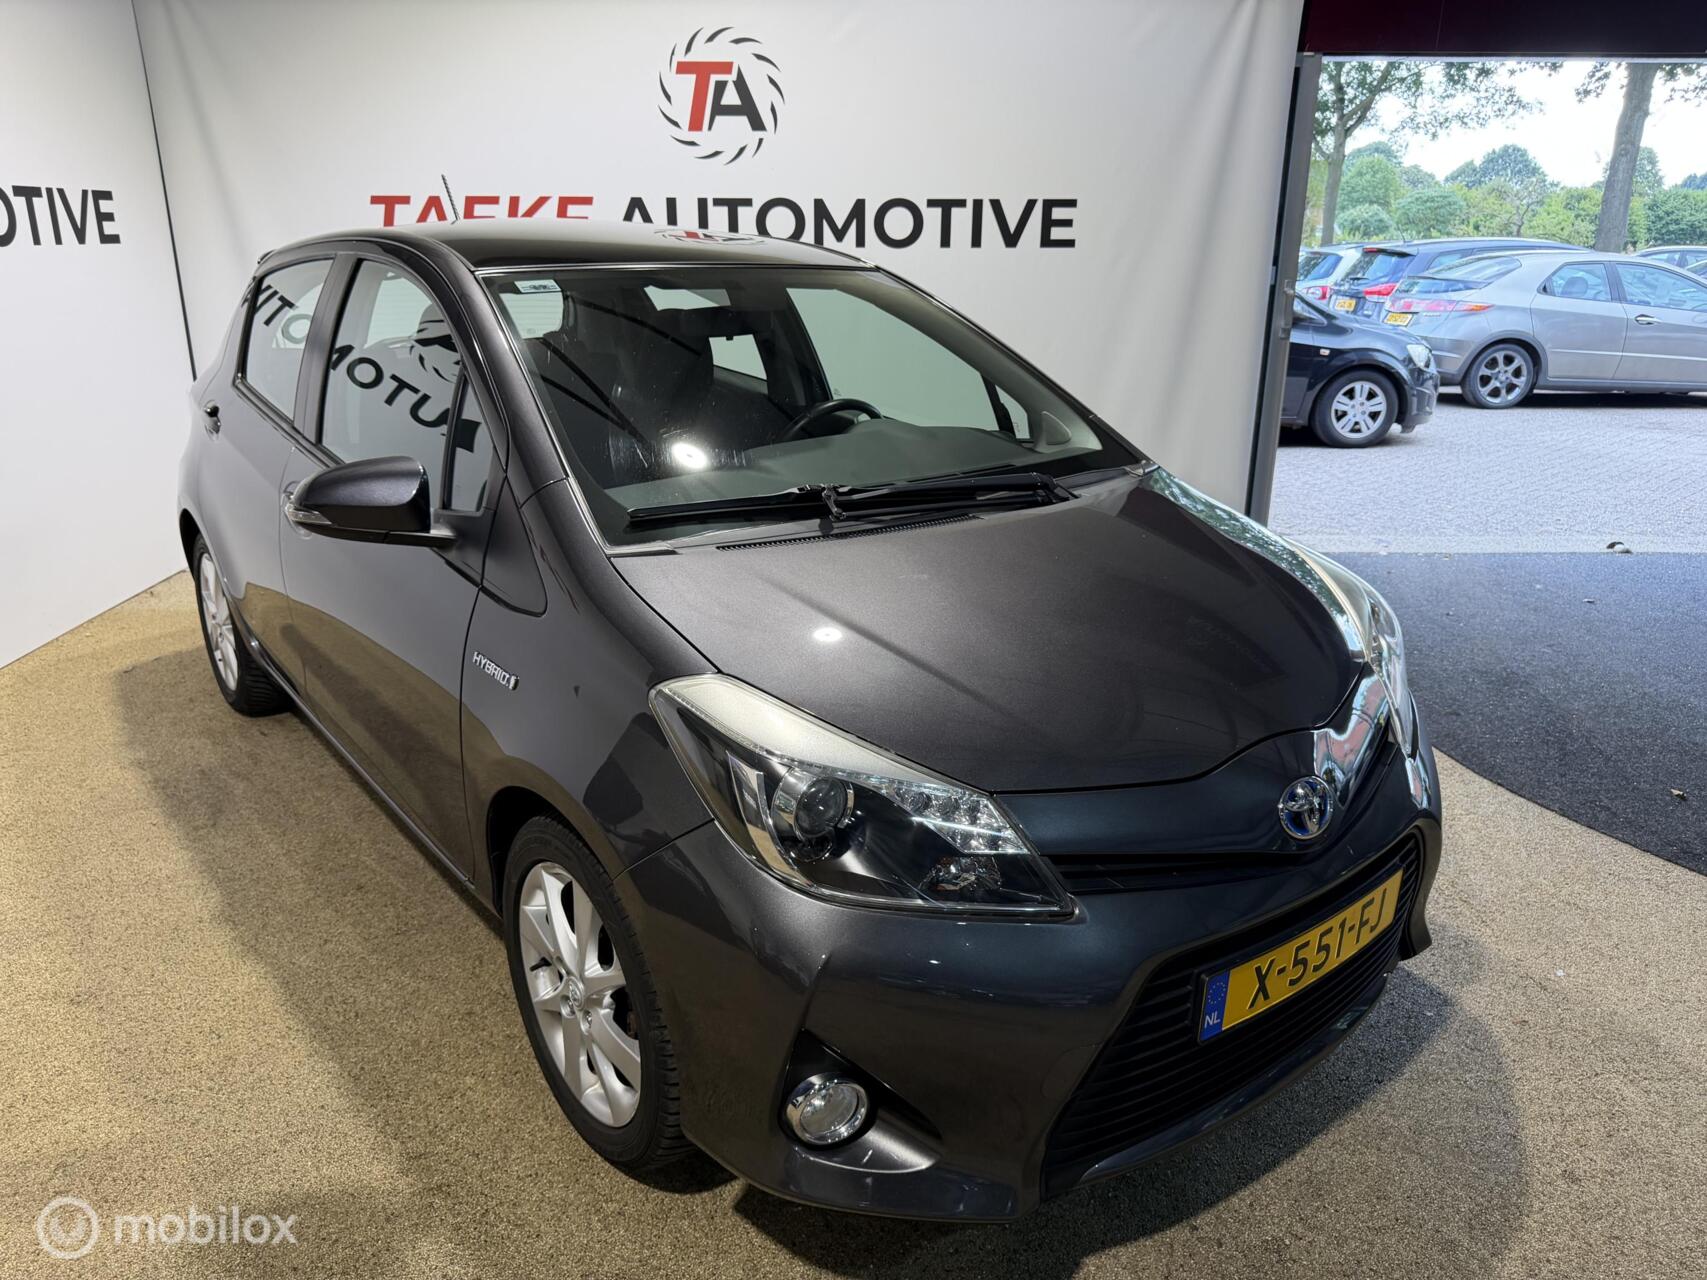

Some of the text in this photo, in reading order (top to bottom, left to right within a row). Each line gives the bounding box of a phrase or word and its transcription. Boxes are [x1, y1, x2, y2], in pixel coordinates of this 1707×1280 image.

[675, 61, 767, 132] TA
[622, 197, 1078, 248] AUTOMOTIVE
[472, 651, 510, 686] HYBRID
[1247, 888, 1387, 1010] X-551-FJ
[1204, 1011, 1221, 1029] NL
